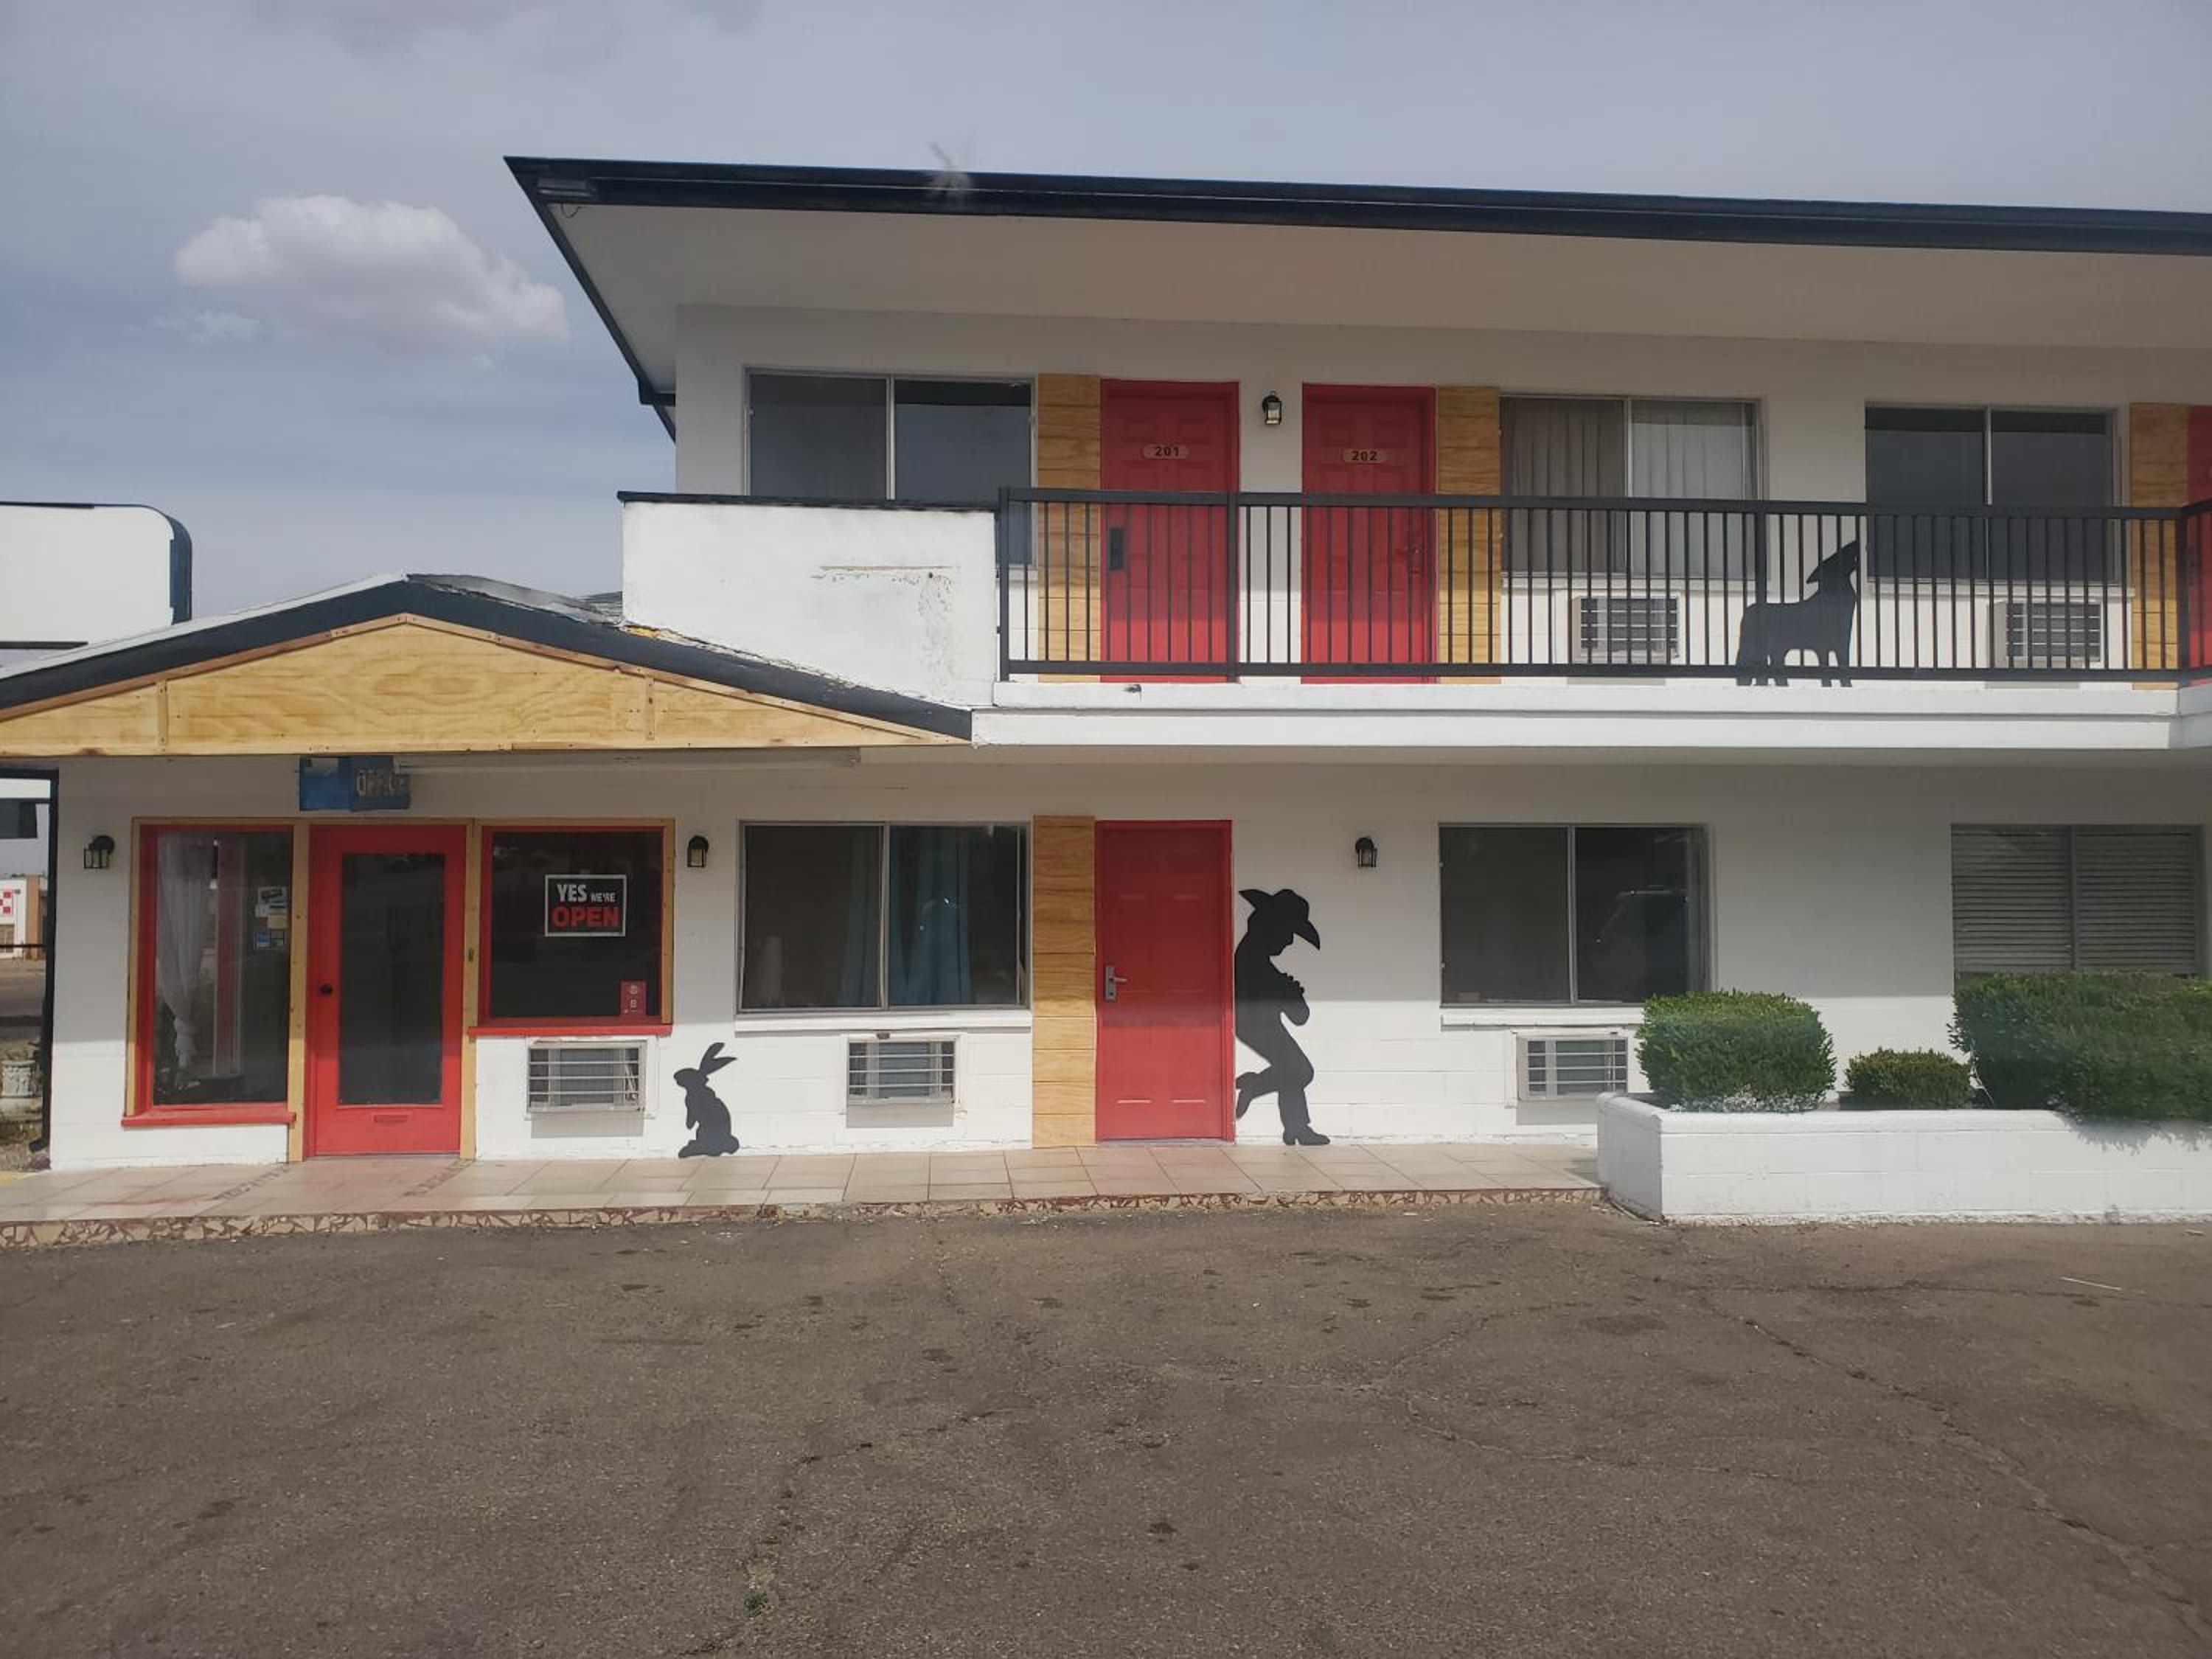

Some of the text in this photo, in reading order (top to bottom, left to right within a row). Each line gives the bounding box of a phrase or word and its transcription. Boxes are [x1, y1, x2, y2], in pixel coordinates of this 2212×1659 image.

[1155, 445, 1180, 456] 201
[1351, 450, 1378, 461] 202
[557, 883, 588, 902] YES
[551, 905, 619, 928] OPEN
